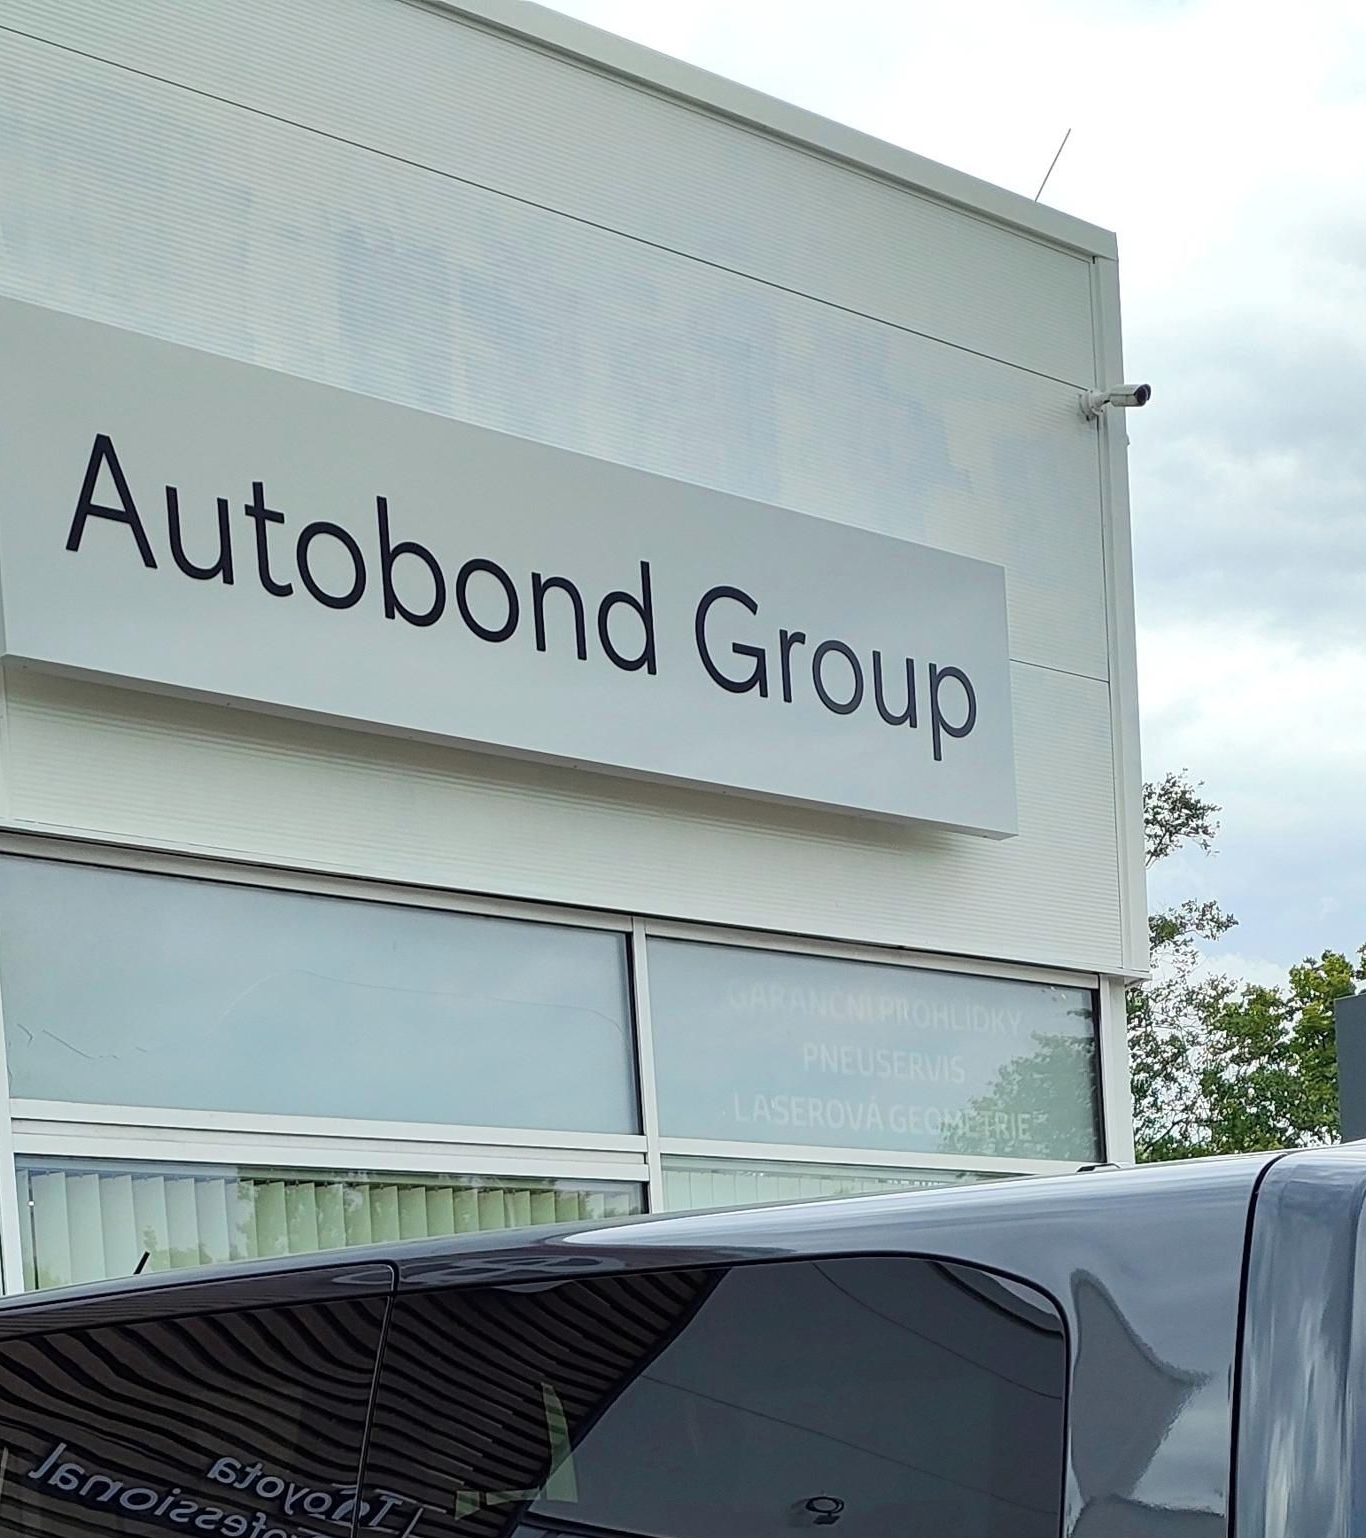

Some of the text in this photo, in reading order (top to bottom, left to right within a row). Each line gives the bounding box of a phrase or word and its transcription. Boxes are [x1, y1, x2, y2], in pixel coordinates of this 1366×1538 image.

[64, 432, 978, 762] Autobond Group
[803, 1041, 966, 1085] PNEUSERVIS
[733, 1090, 1032, 1141] LASEROVÁ GEOMETRIE
